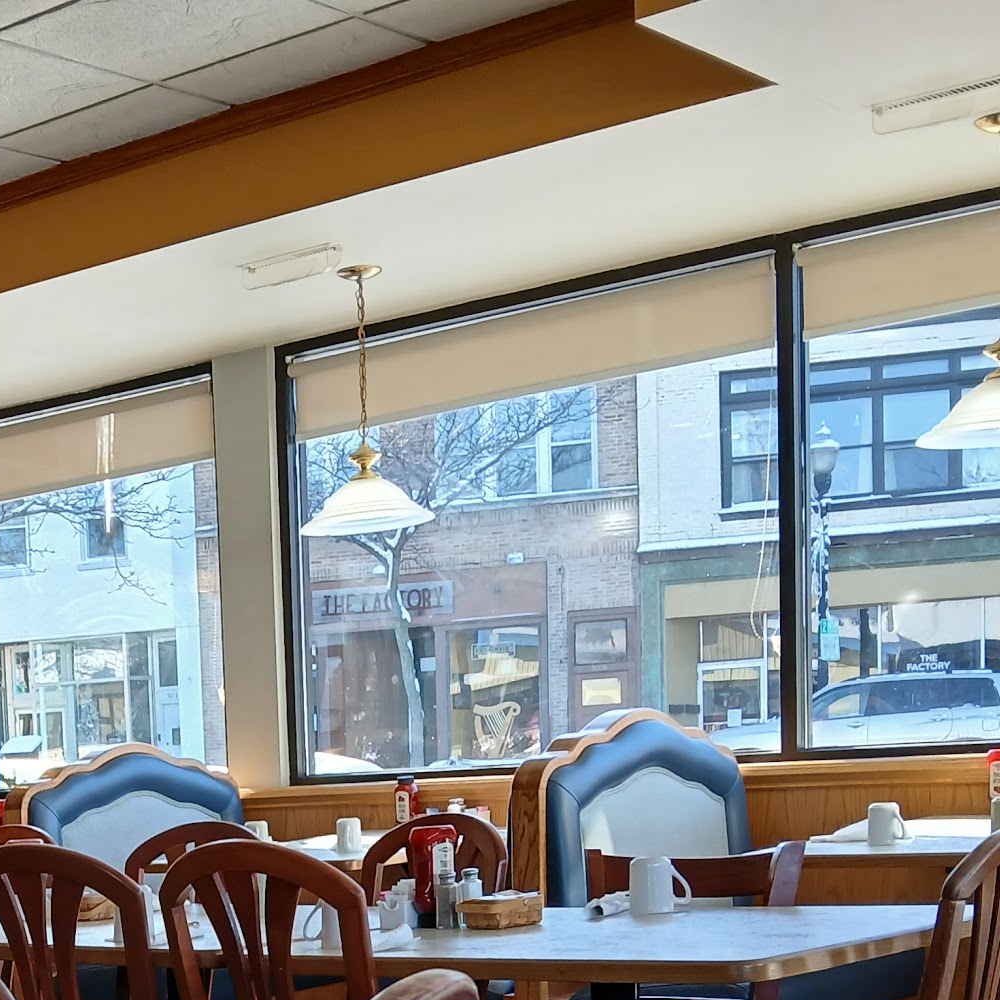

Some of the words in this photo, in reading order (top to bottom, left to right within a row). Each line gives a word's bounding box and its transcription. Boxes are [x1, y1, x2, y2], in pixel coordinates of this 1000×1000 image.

[321, 593, 355, 616] THE
[920, 653, 938, 663] THE
[906, 661, 951, 671] FACTORY
